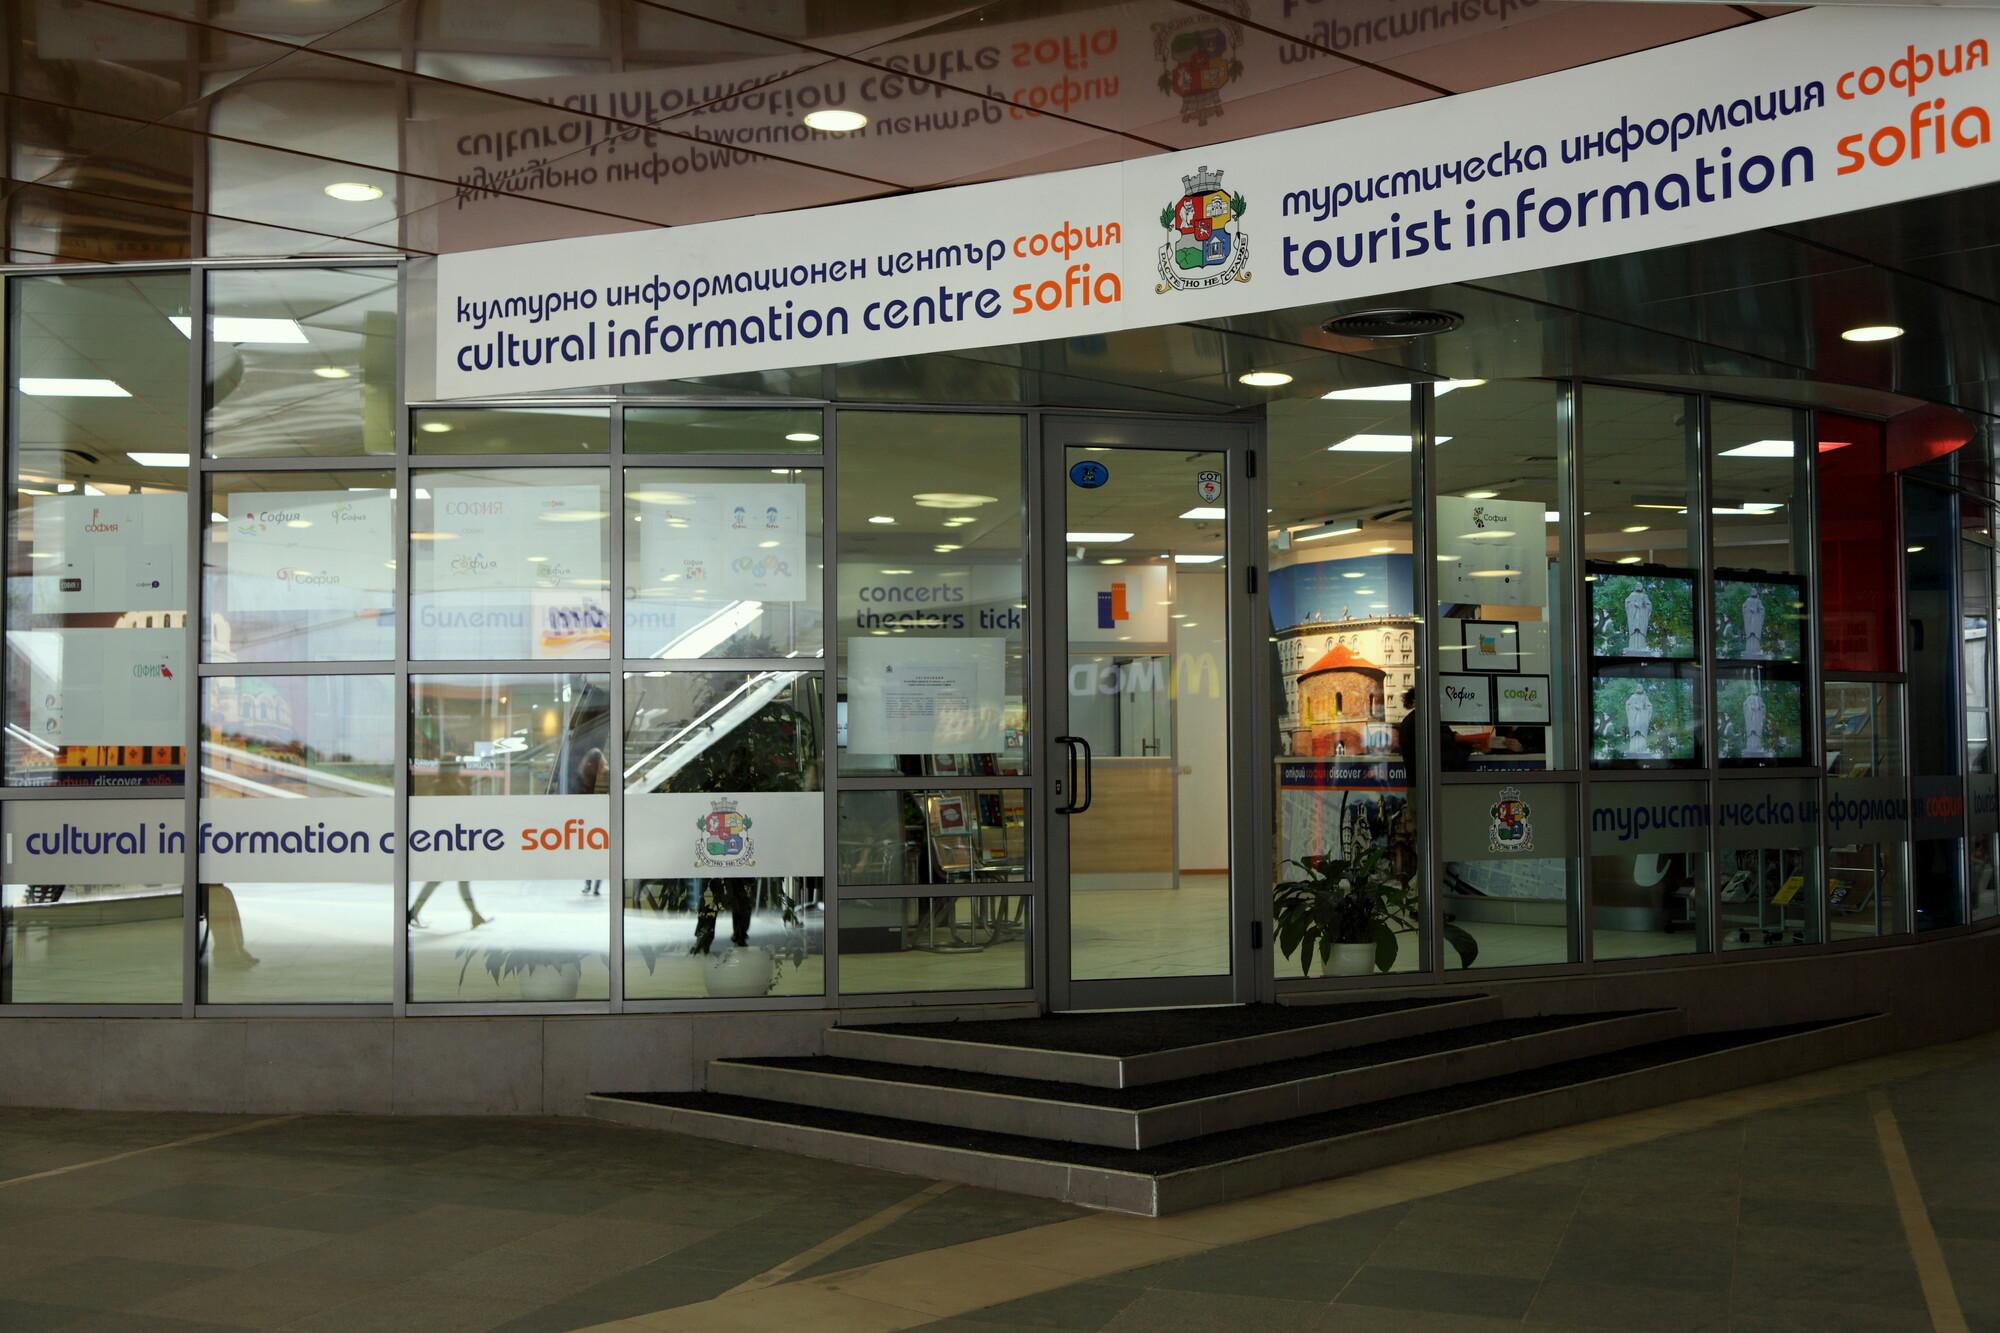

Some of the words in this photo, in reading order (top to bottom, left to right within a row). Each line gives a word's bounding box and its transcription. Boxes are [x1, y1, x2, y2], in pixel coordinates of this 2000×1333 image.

[1282, 141, 1548, 223] туристическа
[1561, 80, 1825, 188] информация
[1836, 38, 1989, 103] софия
[1282, 208, 1452, 278] tourist
[1465, 145, 1815, 248] information
[1836, 96, 1992, 176] sofia
[457, 288, 597, 328] културно
[607, 258, 866, 324] информационен
[877, 237, 1006, 282] център
[1012, 221, 1121, 261] софия
[1185, 278, 1200, 288] НО
[1203, 275, 1220, 287] НЕ
[457, 321, 596, 372] cultural
[608, 301, 849, 357] information
[863, 287, 1001, 331] centre
[1011, 262, 1122, 315] sofia
[856, 607, 965, 630] theaters
[858, 582, 964, 603] concerts
[26, 824, 145, 855] cultural
[159, 822, 370, 854] information
[379, 823, 504, 854] centre
[521, 818, 609, 852] sofia
